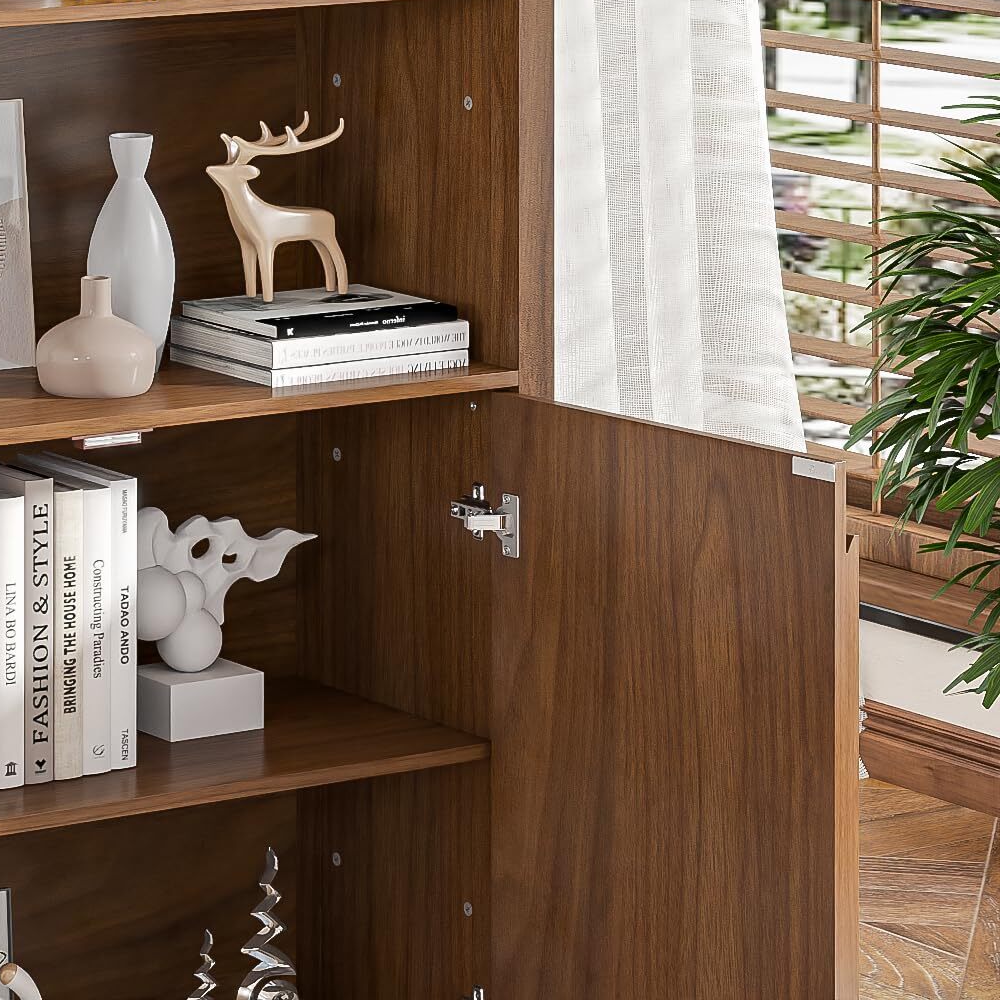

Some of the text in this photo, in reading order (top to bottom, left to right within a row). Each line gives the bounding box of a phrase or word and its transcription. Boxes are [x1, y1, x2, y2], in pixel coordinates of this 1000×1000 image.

[5, 582, 17, 686] LINA BO BARDI
[33, 503, 49, 744] FASHION & STYLE
[63, 555, 76, 714] BRINGING THE HOUSE HOME
[90, 559, 105, 630] Constructing
[120, 585, 130, 665] TADAO ANDO
